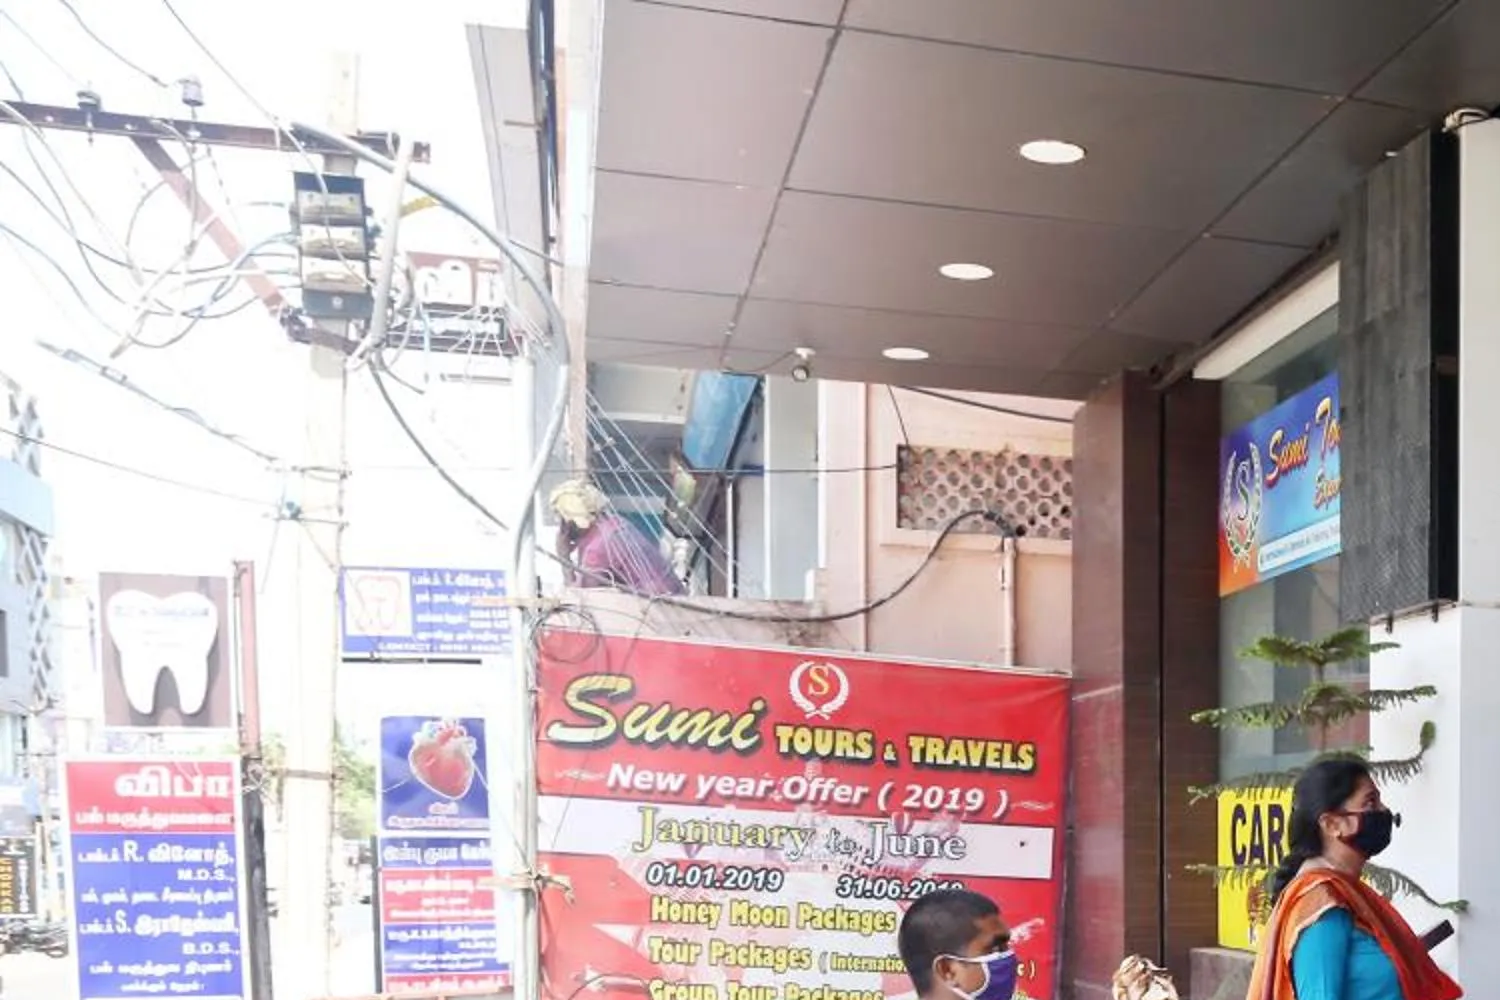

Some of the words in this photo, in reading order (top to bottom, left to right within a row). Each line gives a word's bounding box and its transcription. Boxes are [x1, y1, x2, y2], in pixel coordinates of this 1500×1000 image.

[807, 664, 830, 697] S
[547, 673, 767, 752] Sumi
[774, 724, 875, 760] TOURS
[883, 741, 898, 763] &
[908, 733, 1036, 773] TRAVELS
[607, 763, 687, 791] New
[782, 775, 869, 806] Offer
[633, 806, 816, 863] January
[864, 821, 967, 866] June
[1231, 803, 1293, 867] CAR
[645, 862, 785, 893] 01.01.2019
[650, 896, 722, 926] Honey
[729, 900, 789, 928] Moon
[799, 902, 897, 934] Packages
[648, 937, 702, 966] Tour
[710, 943, 813, 974] Packages
[830, 951, 908, 974] Internatio
